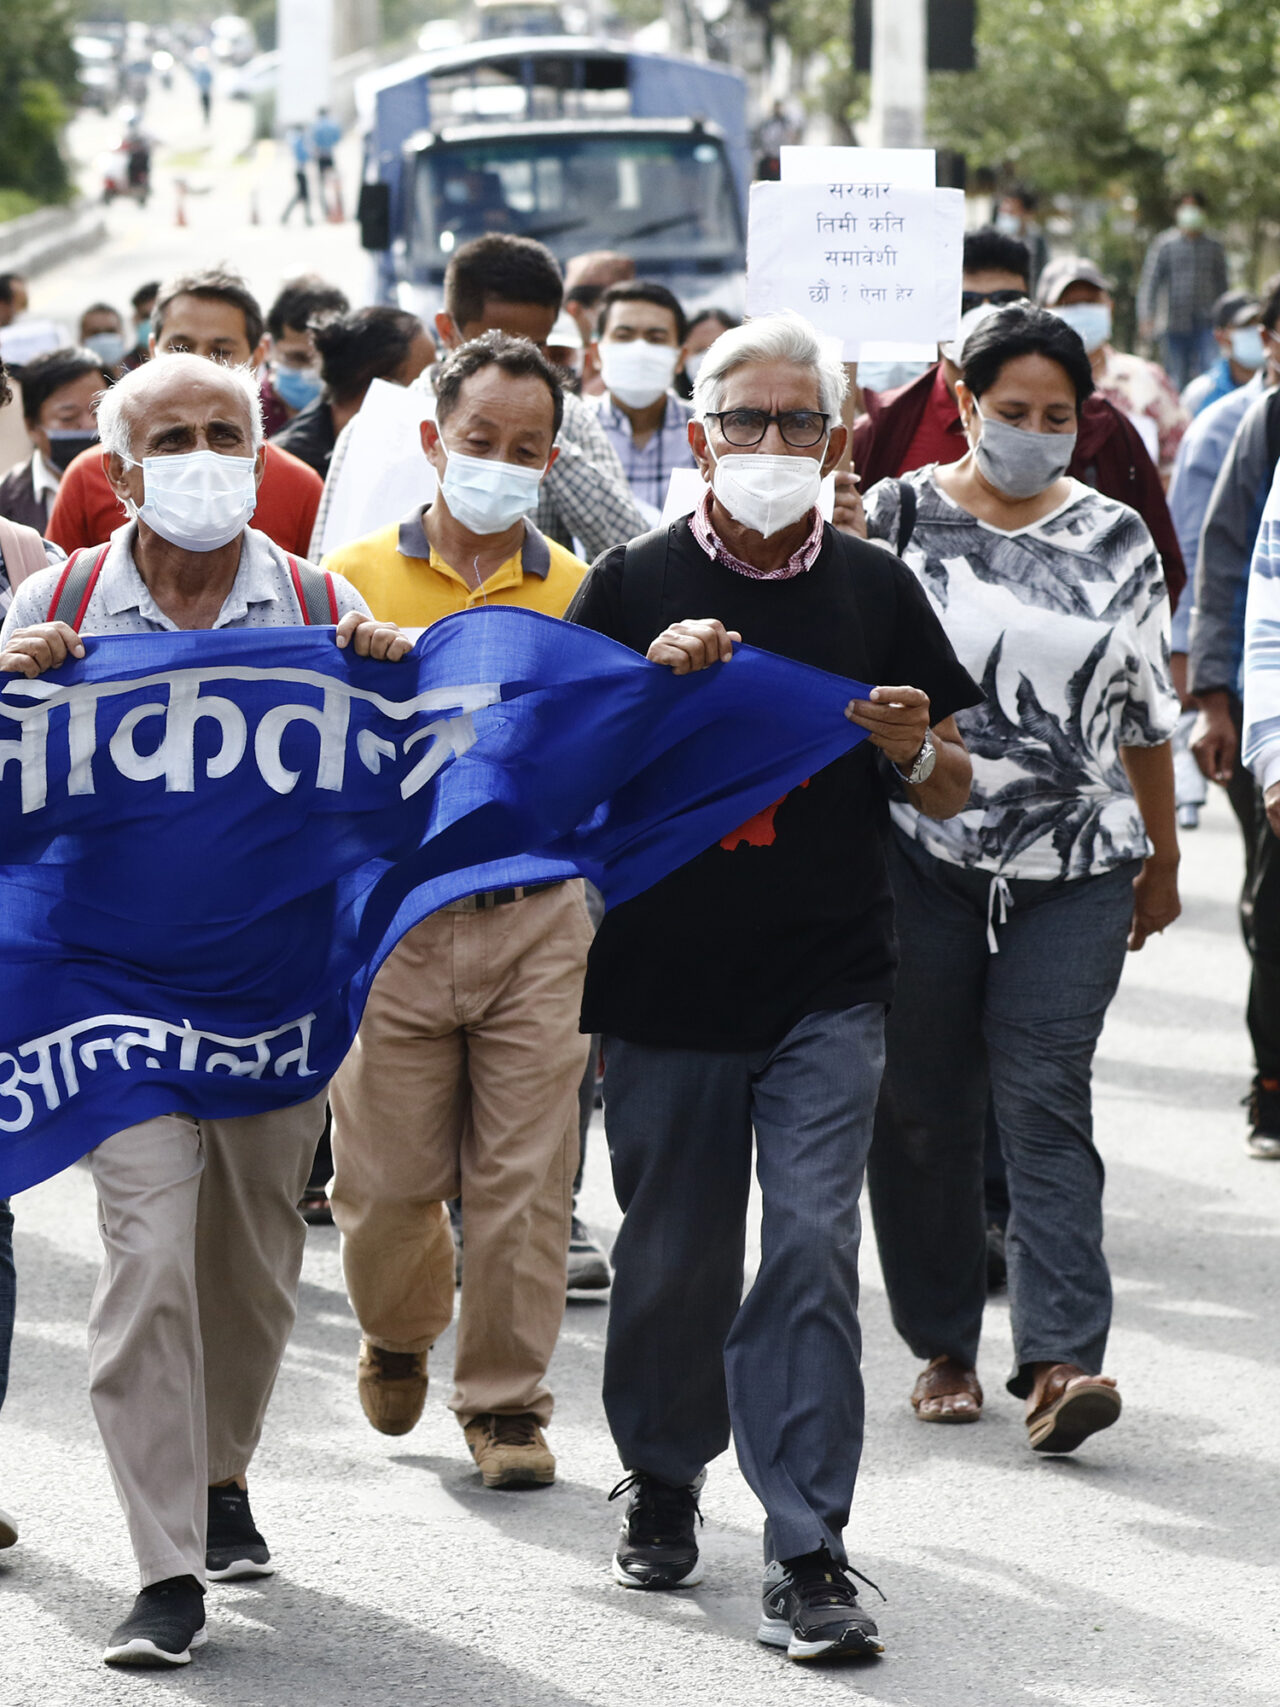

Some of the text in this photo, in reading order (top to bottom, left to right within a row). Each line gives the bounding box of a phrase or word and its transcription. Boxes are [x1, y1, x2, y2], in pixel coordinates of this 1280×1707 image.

[827, 183, 893, 200] सरकार
[816, 211, 906, 233] तिमी कति
[824, 245, 899, 266] समावेशी
[859, 283, 888, 304] ऐना
[895, 283, 915, 301] हेर
